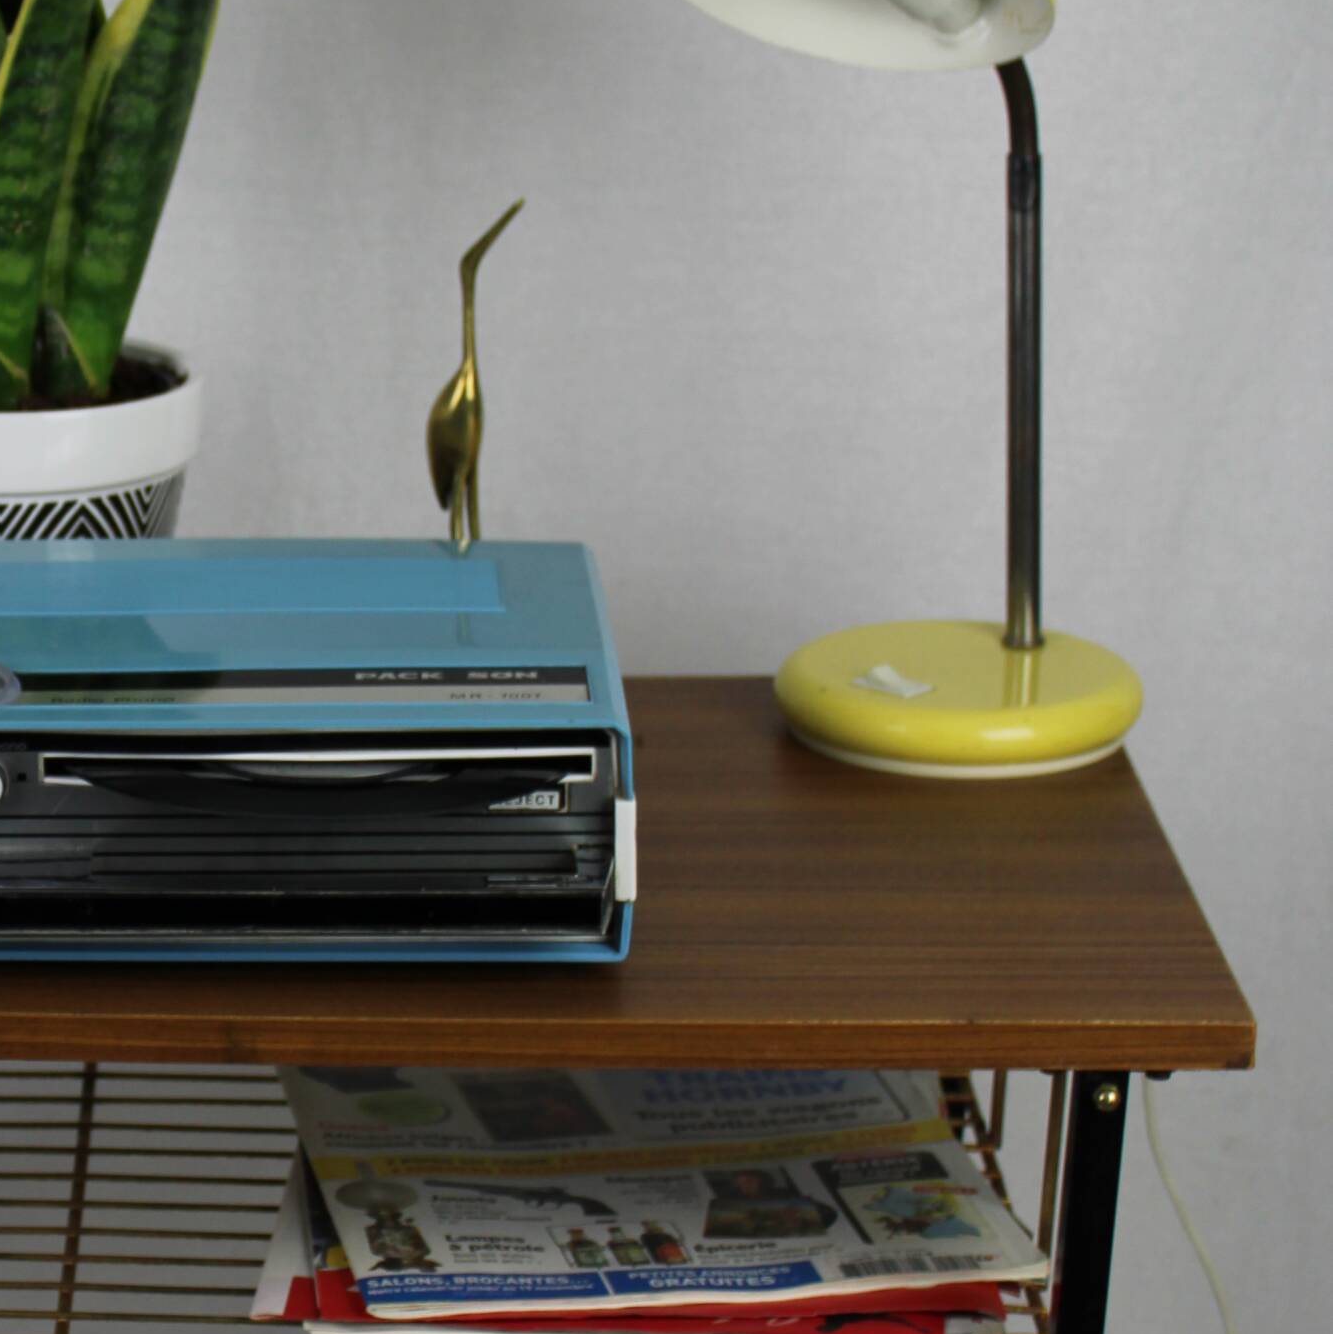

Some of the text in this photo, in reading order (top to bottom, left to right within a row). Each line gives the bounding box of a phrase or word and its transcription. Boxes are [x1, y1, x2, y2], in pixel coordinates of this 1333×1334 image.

[354, 670, 444, 681] PACK
[497, 794, 556, 806] JECT
[650, 1275, 777, 1288] GRATUITES
